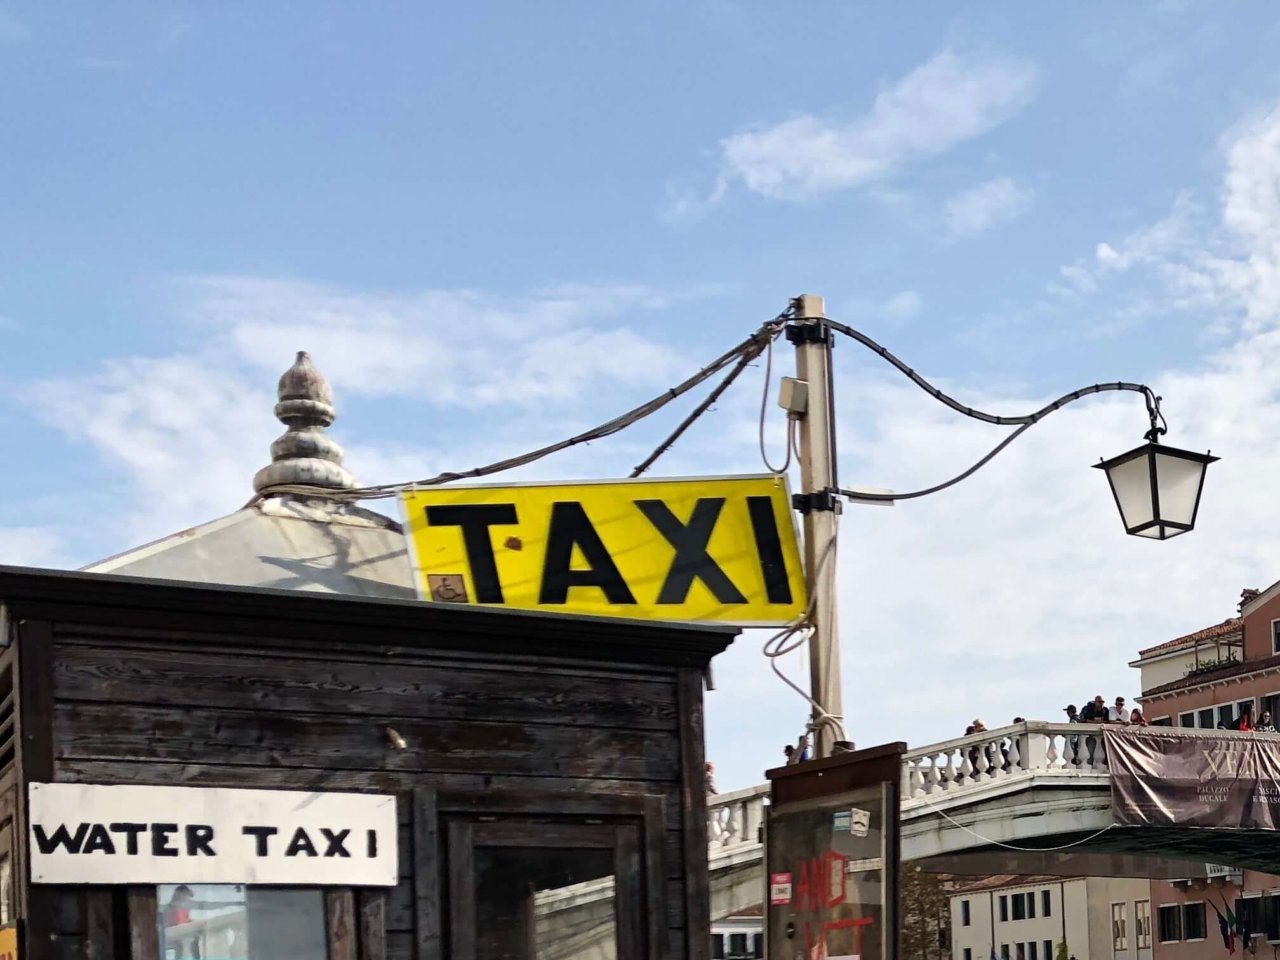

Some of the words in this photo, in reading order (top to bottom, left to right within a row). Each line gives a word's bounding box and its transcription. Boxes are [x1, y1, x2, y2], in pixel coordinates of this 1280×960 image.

[425, 496, 793, 605] TAXI
[32, 822, 217, 857] WATER
[242, 826, 377, 858] TAXI
